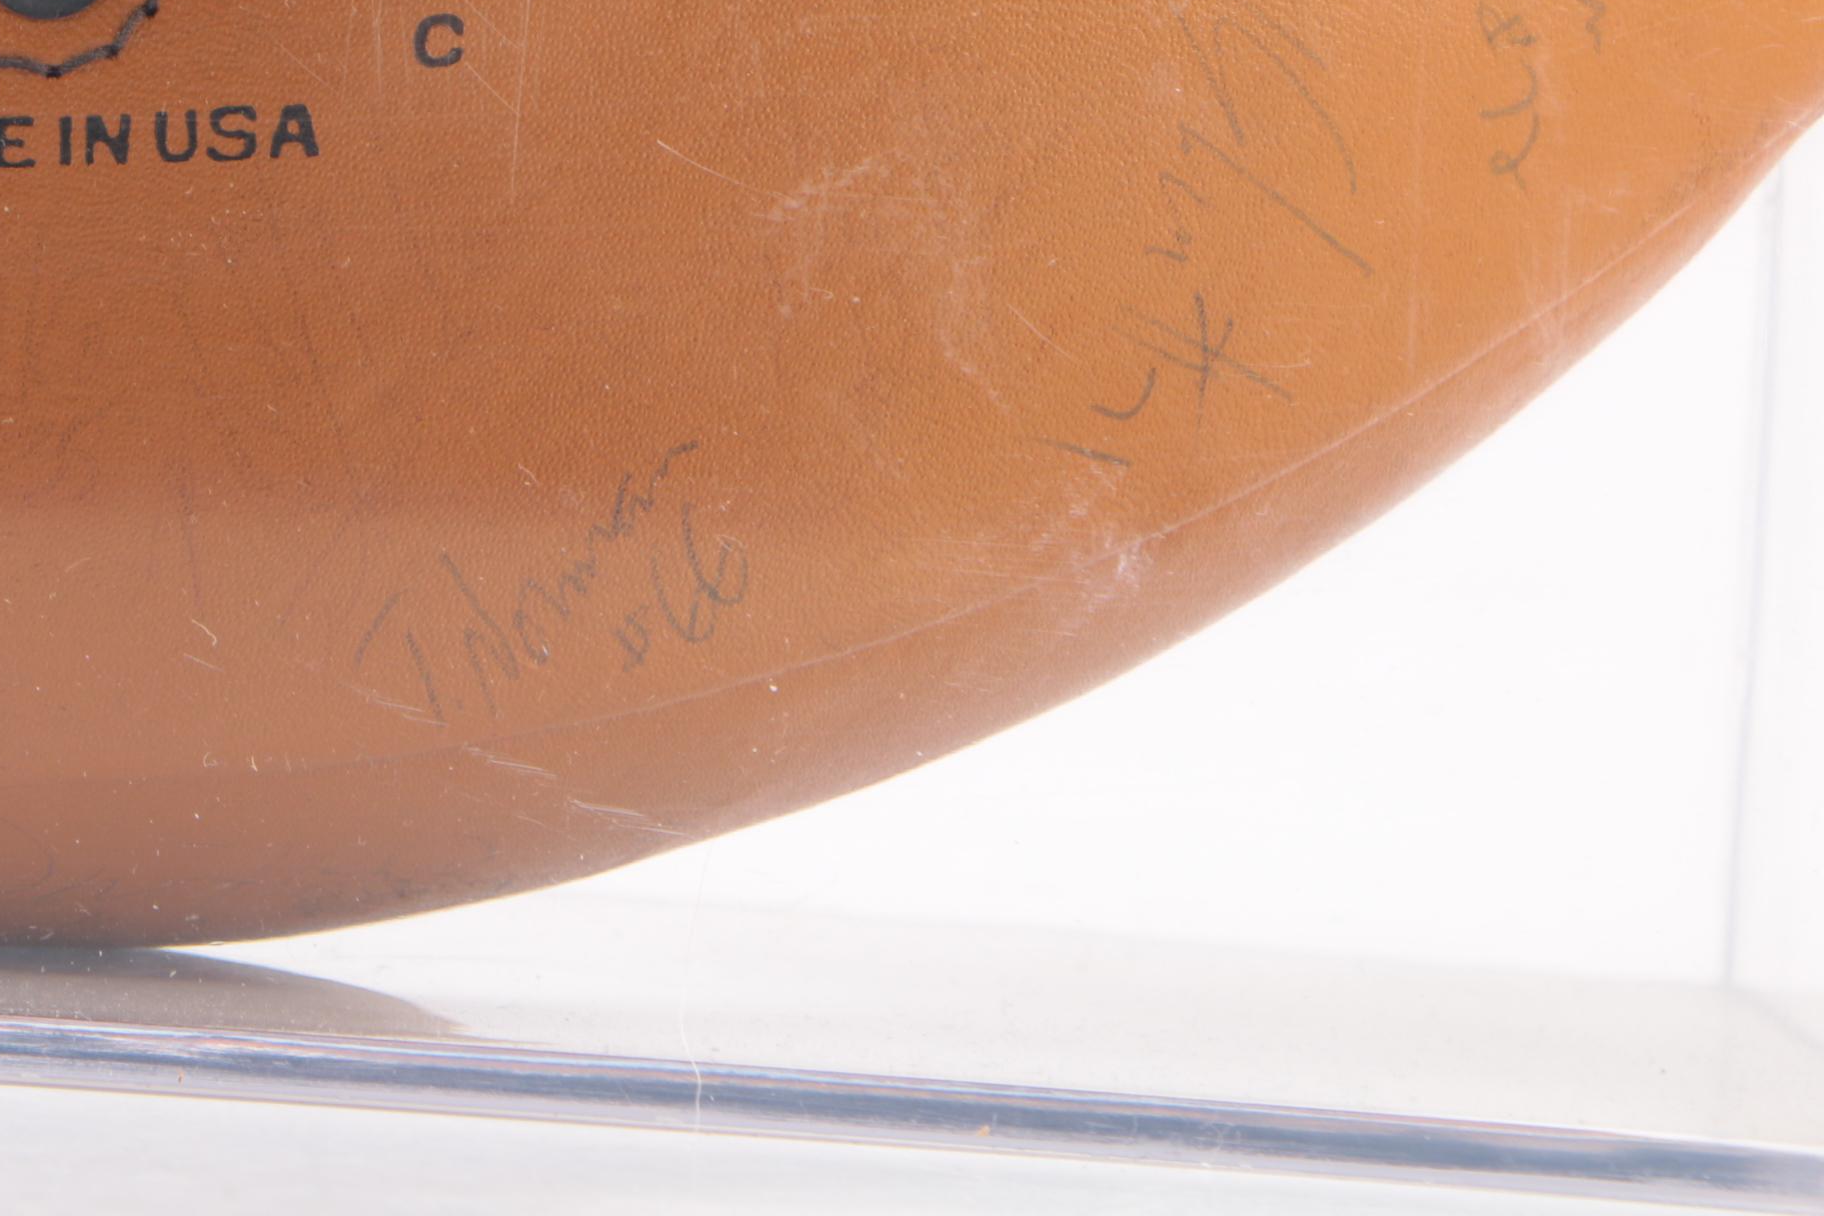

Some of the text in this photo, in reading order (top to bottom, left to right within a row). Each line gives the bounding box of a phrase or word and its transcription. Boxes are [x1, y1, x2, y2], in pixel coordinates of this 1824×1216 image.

[413, 11, 467, 68] C
[58, 113, 133, 167] IN
[153, 103, 321, 164] USA
